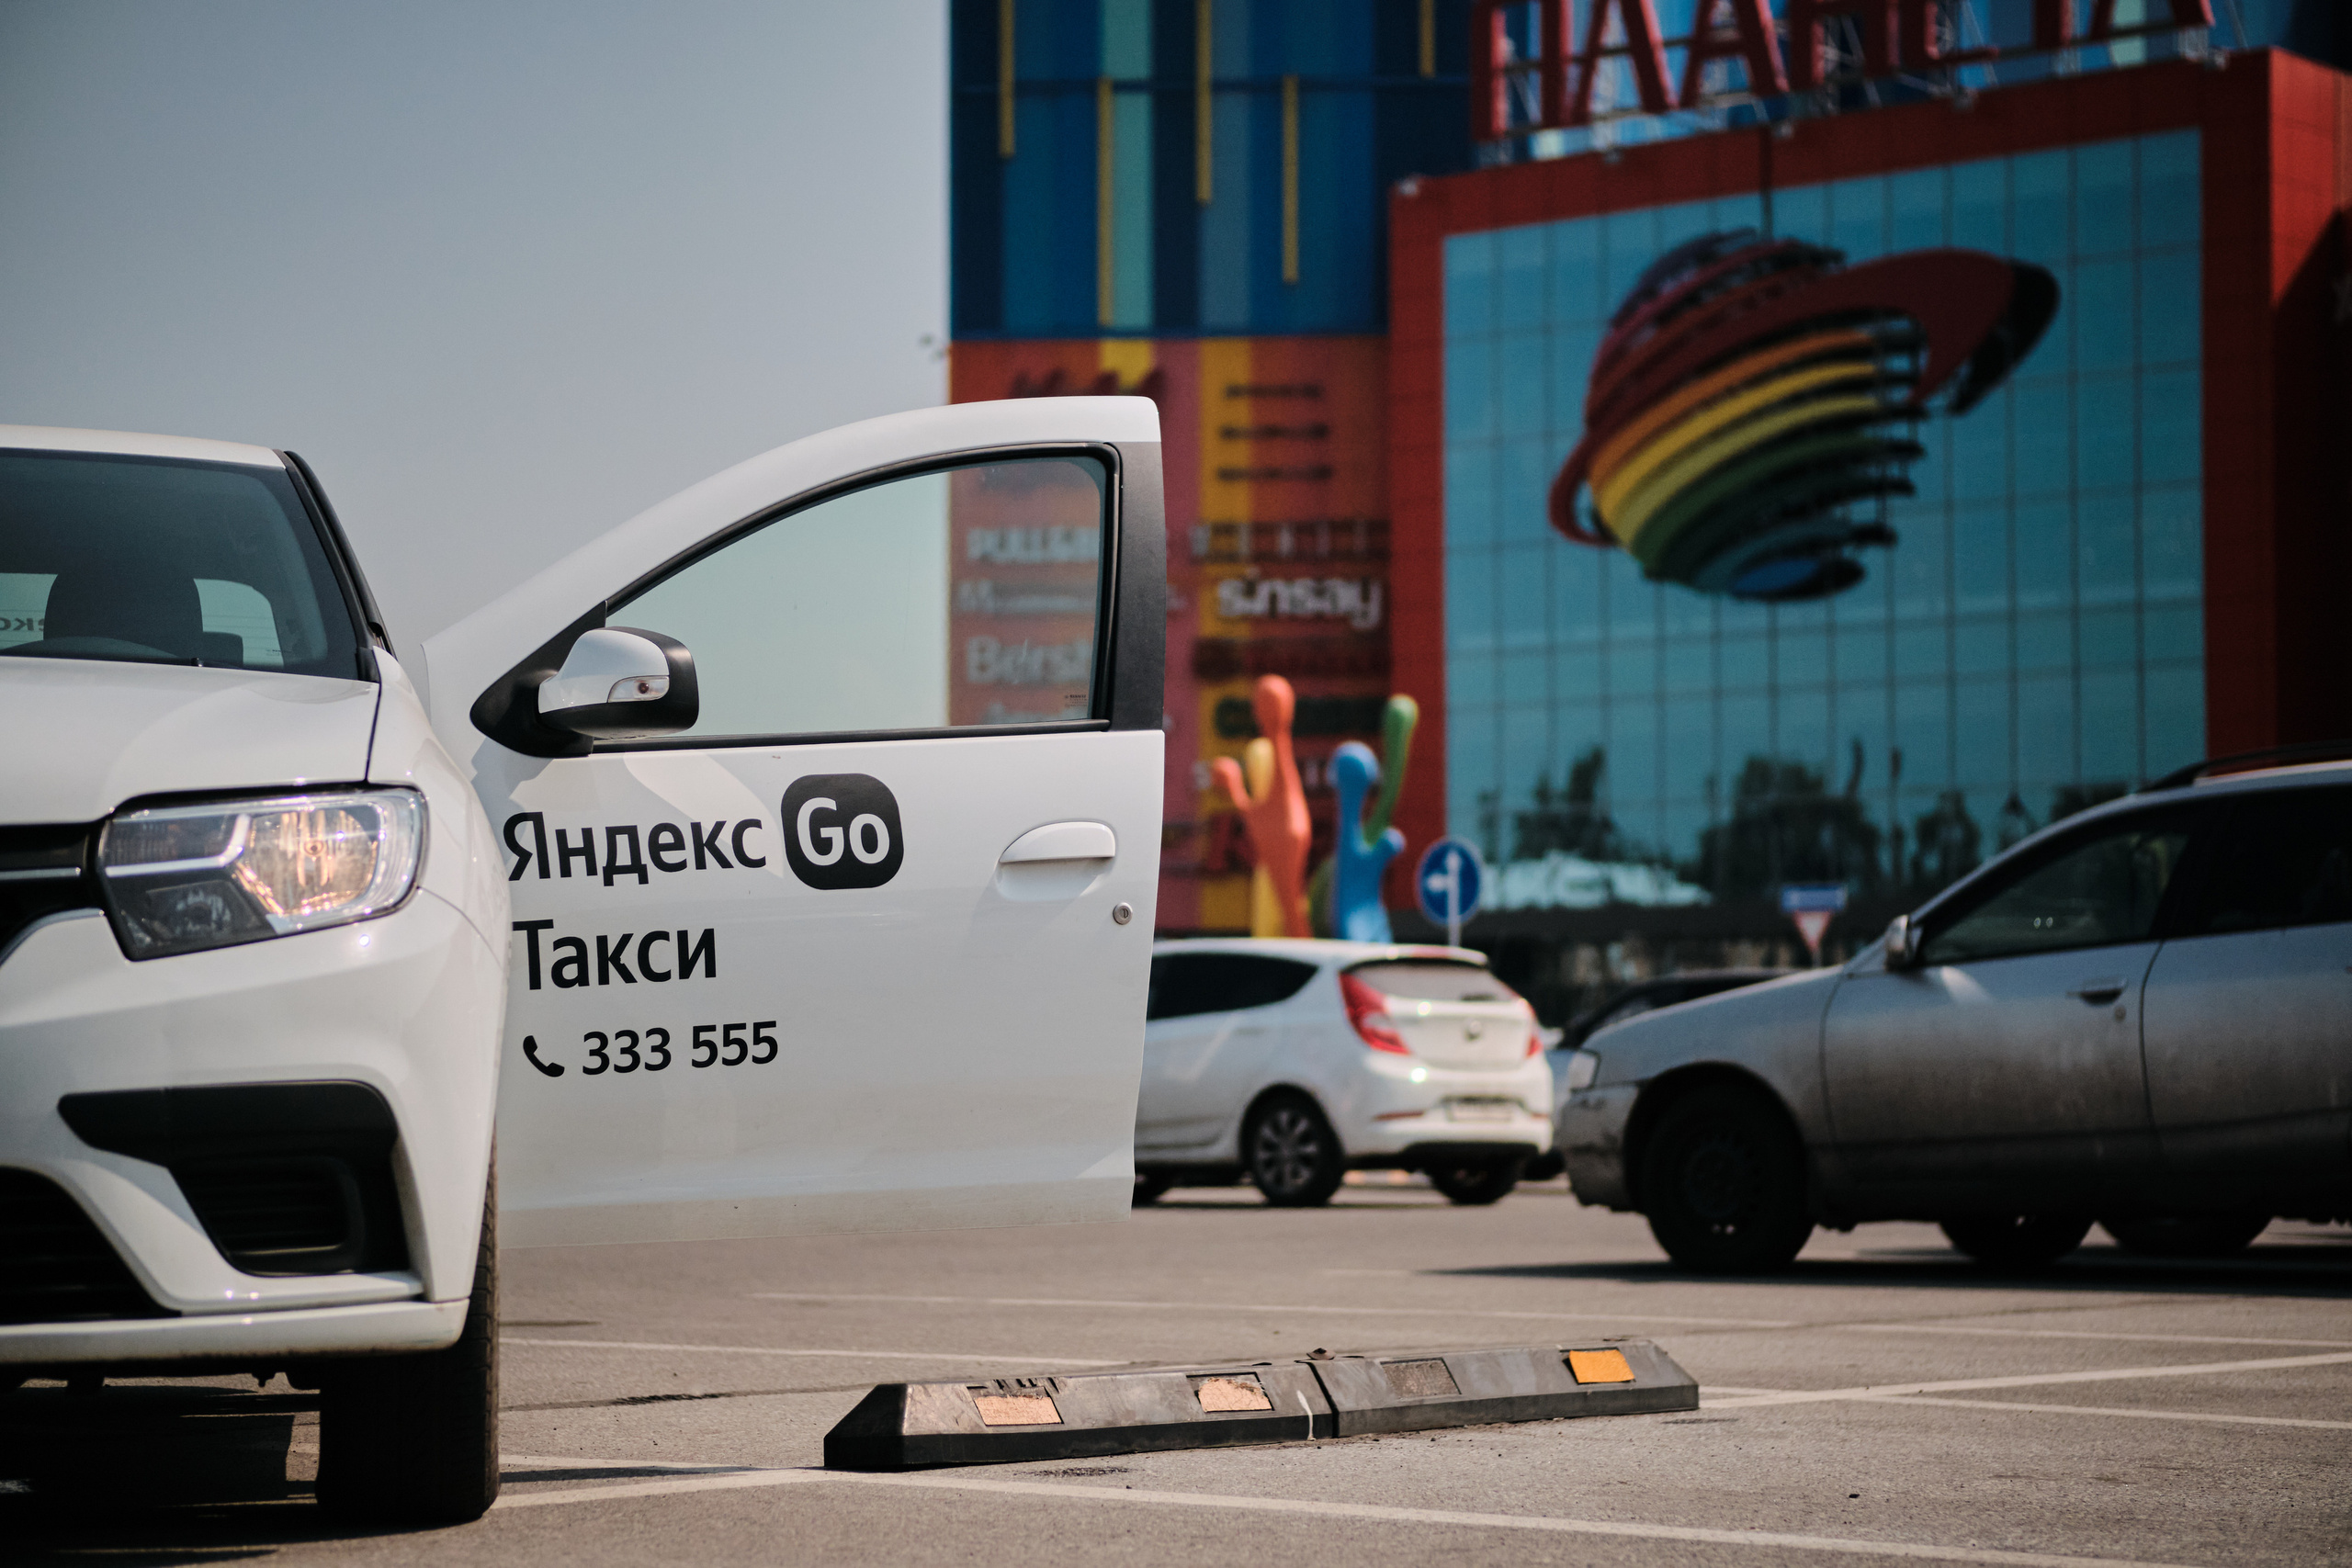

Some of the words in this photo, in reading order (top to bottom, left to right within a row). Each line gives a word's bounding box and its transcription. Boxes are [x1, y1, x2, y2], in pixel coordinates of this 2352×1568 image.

[1217, 567, 1383, 630] sinsay
[503, 812, 766, 886] Яндекс
[797, 797, 891, 866] Go
[512, 919, 717, 990] Такси
[582, 1028, 672, 1076] 333
[691, 1021, 778, 1068] 555
